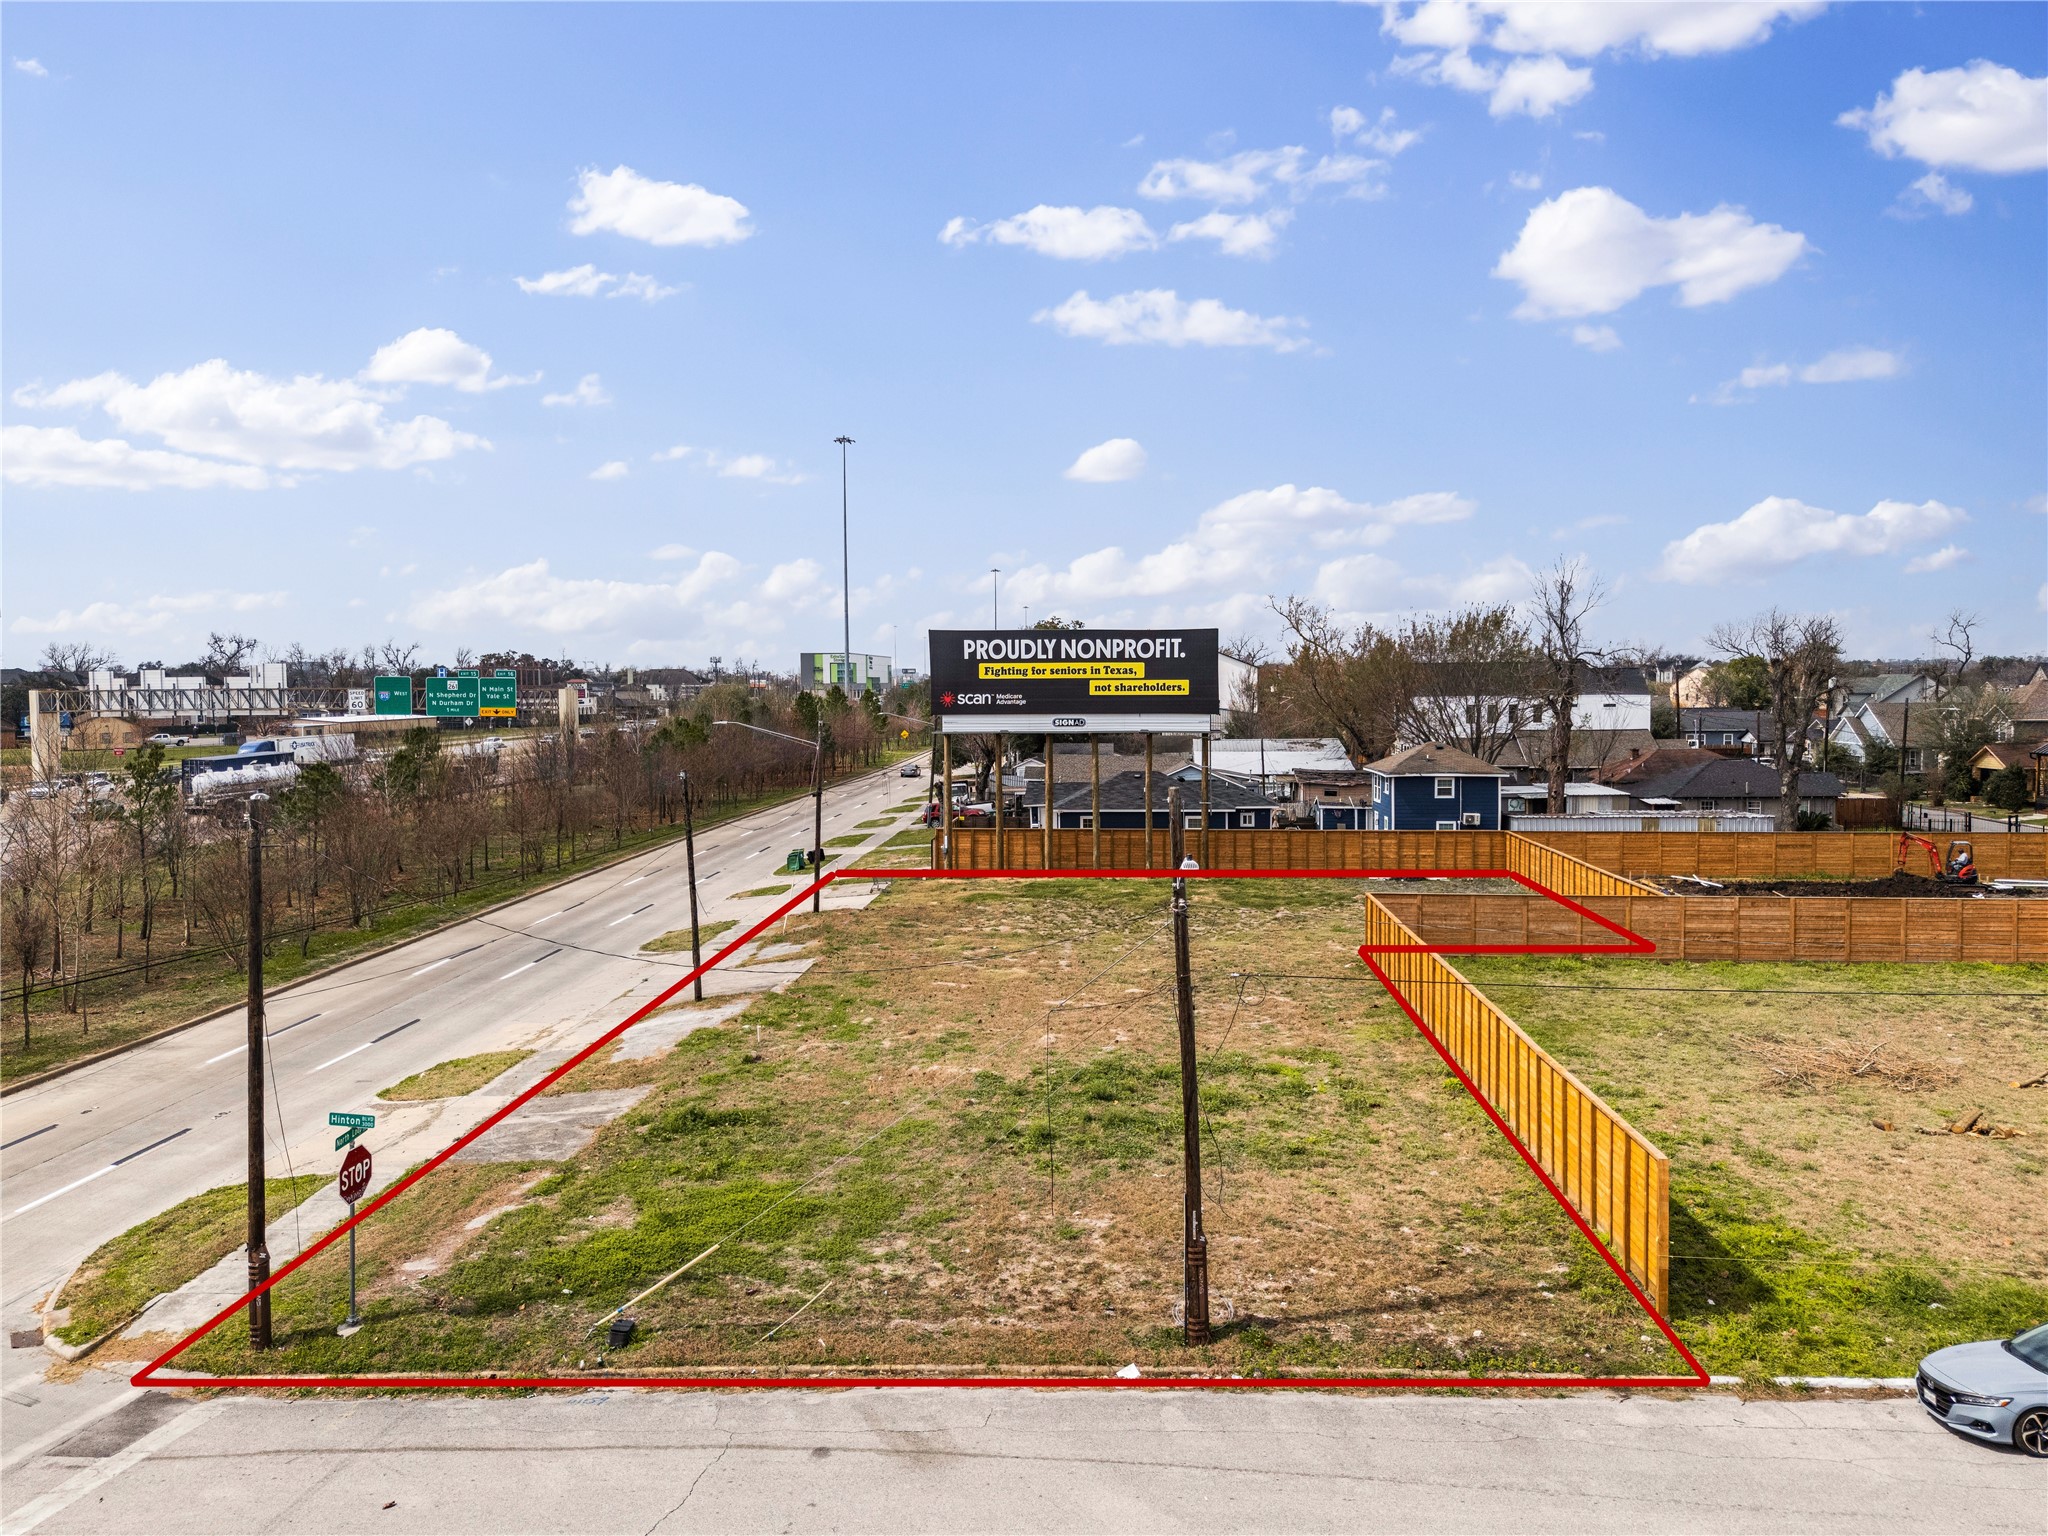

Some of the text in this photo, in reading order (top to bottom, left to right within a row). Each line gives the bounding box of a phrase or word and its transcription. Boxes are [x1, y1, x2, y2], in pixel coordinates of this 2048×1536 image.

[963, 638, 1186, 660] PROUDLY NONPROFIT.
[984, 665, 1137, 677] Fighting for seniors in Texas,
[1094, 683, 1186, 692] not shareholders.
[331, 1114, 361, 1125] Hinton
[336, 1133, 350, 1147] North
[341, 1158, 371, 1191] STOP
